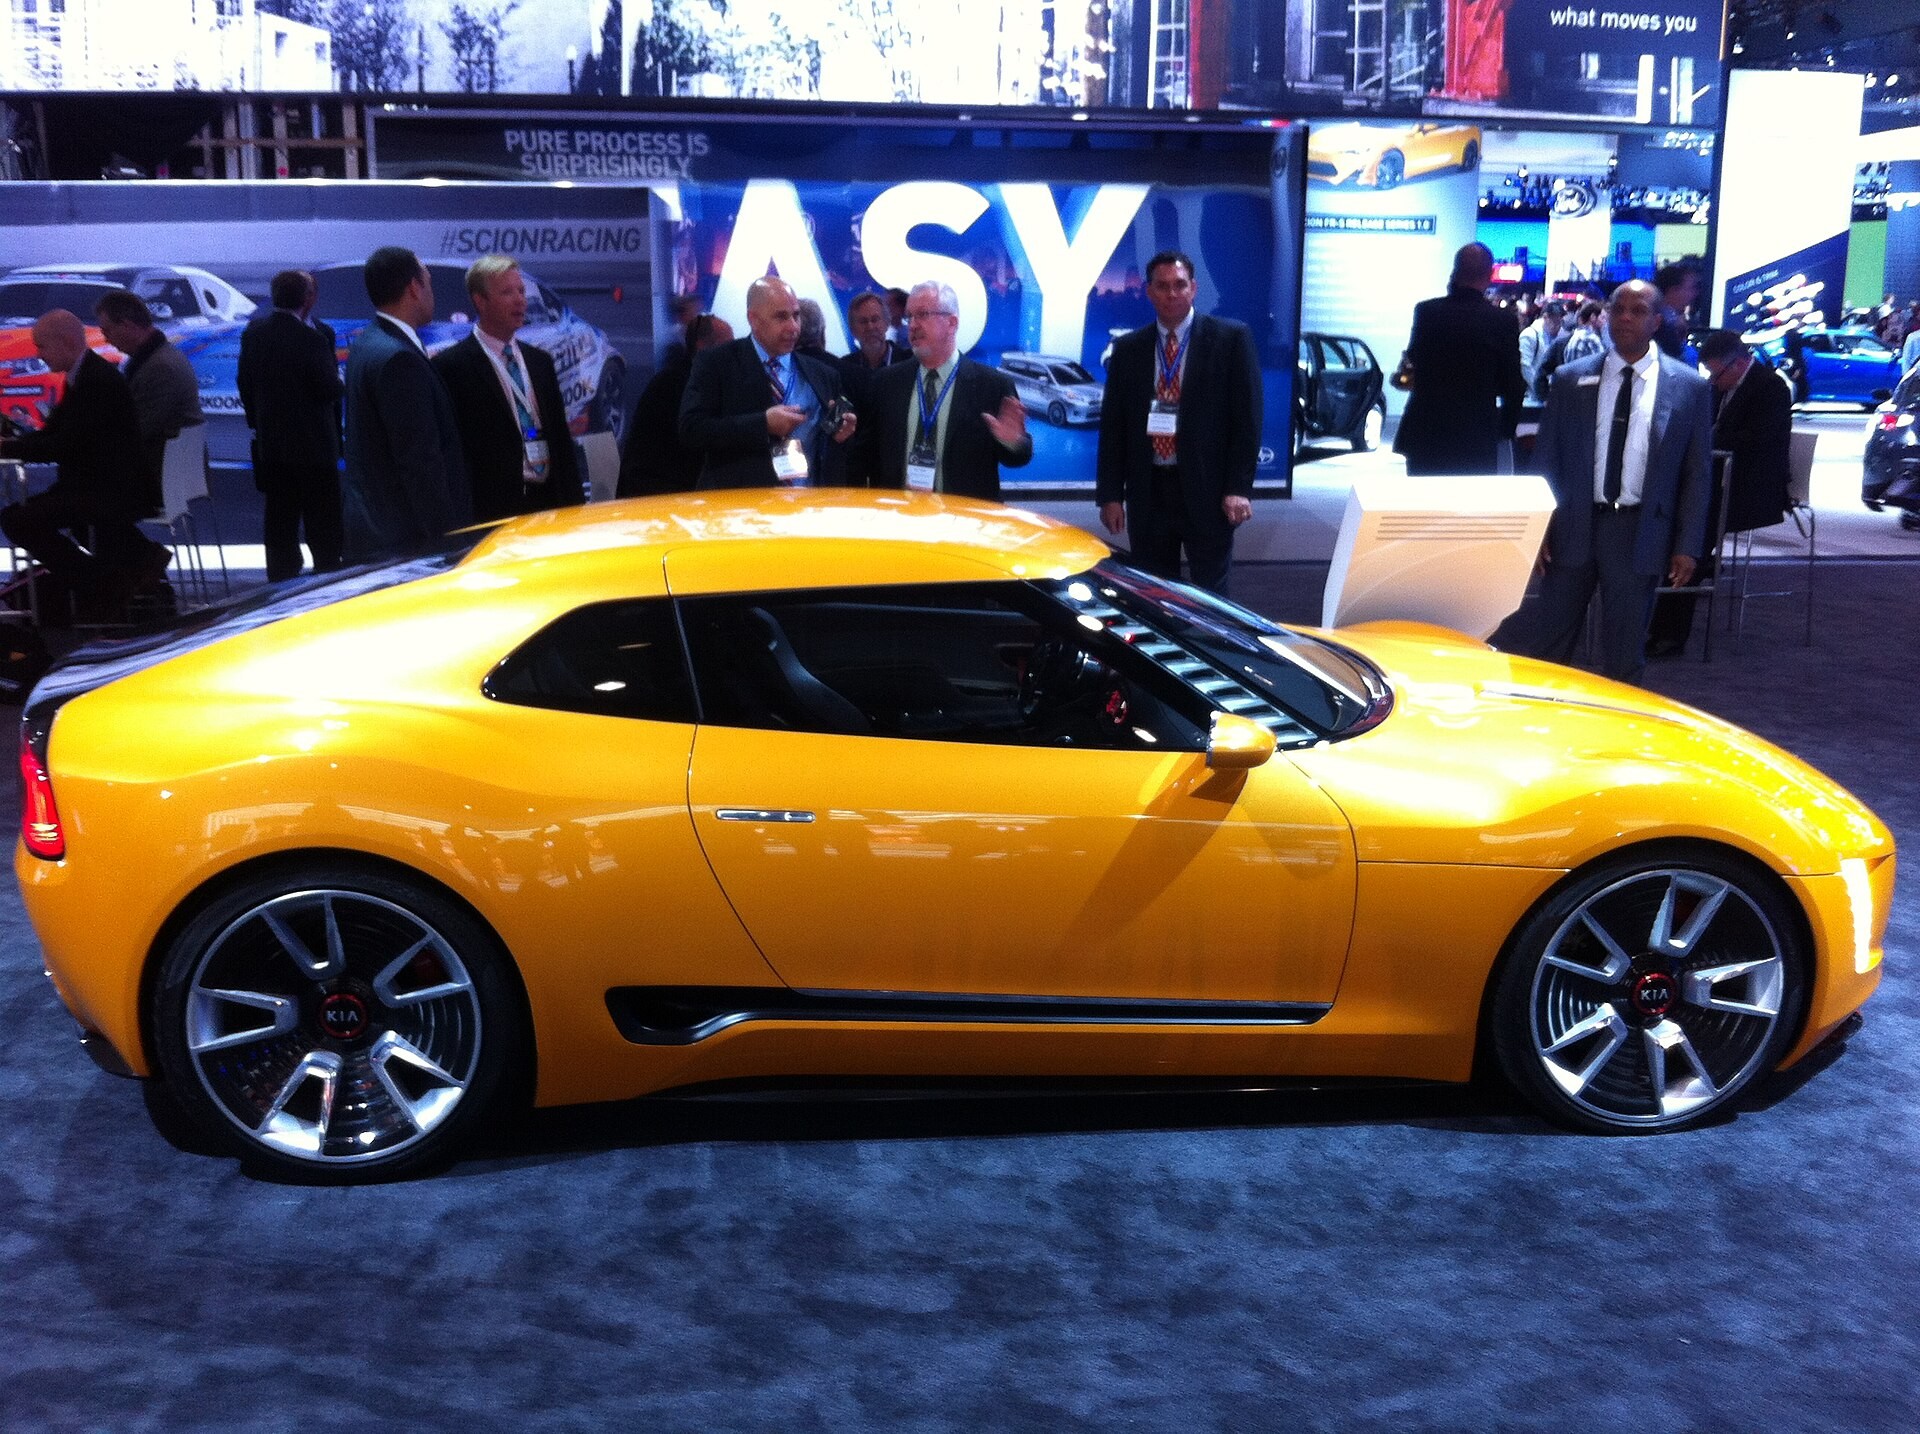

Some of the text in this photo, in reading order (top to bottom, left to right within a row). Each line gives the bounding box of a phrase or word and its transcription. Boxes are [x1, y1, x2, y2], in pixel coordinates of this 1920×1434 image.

[1550, 5, 1698, 36] what moves you
[504, 129, 710, 157] PURE PROCESS IS
[520, 154, 691, 179] SURPRISINGLY
[440, 226, 641, 255] #SCIONRACING
[652, 178, 1152, 366] ASY
[1640, 988, 1668, 1001] KIA
[326, 1010, 359, 1022] KIA
